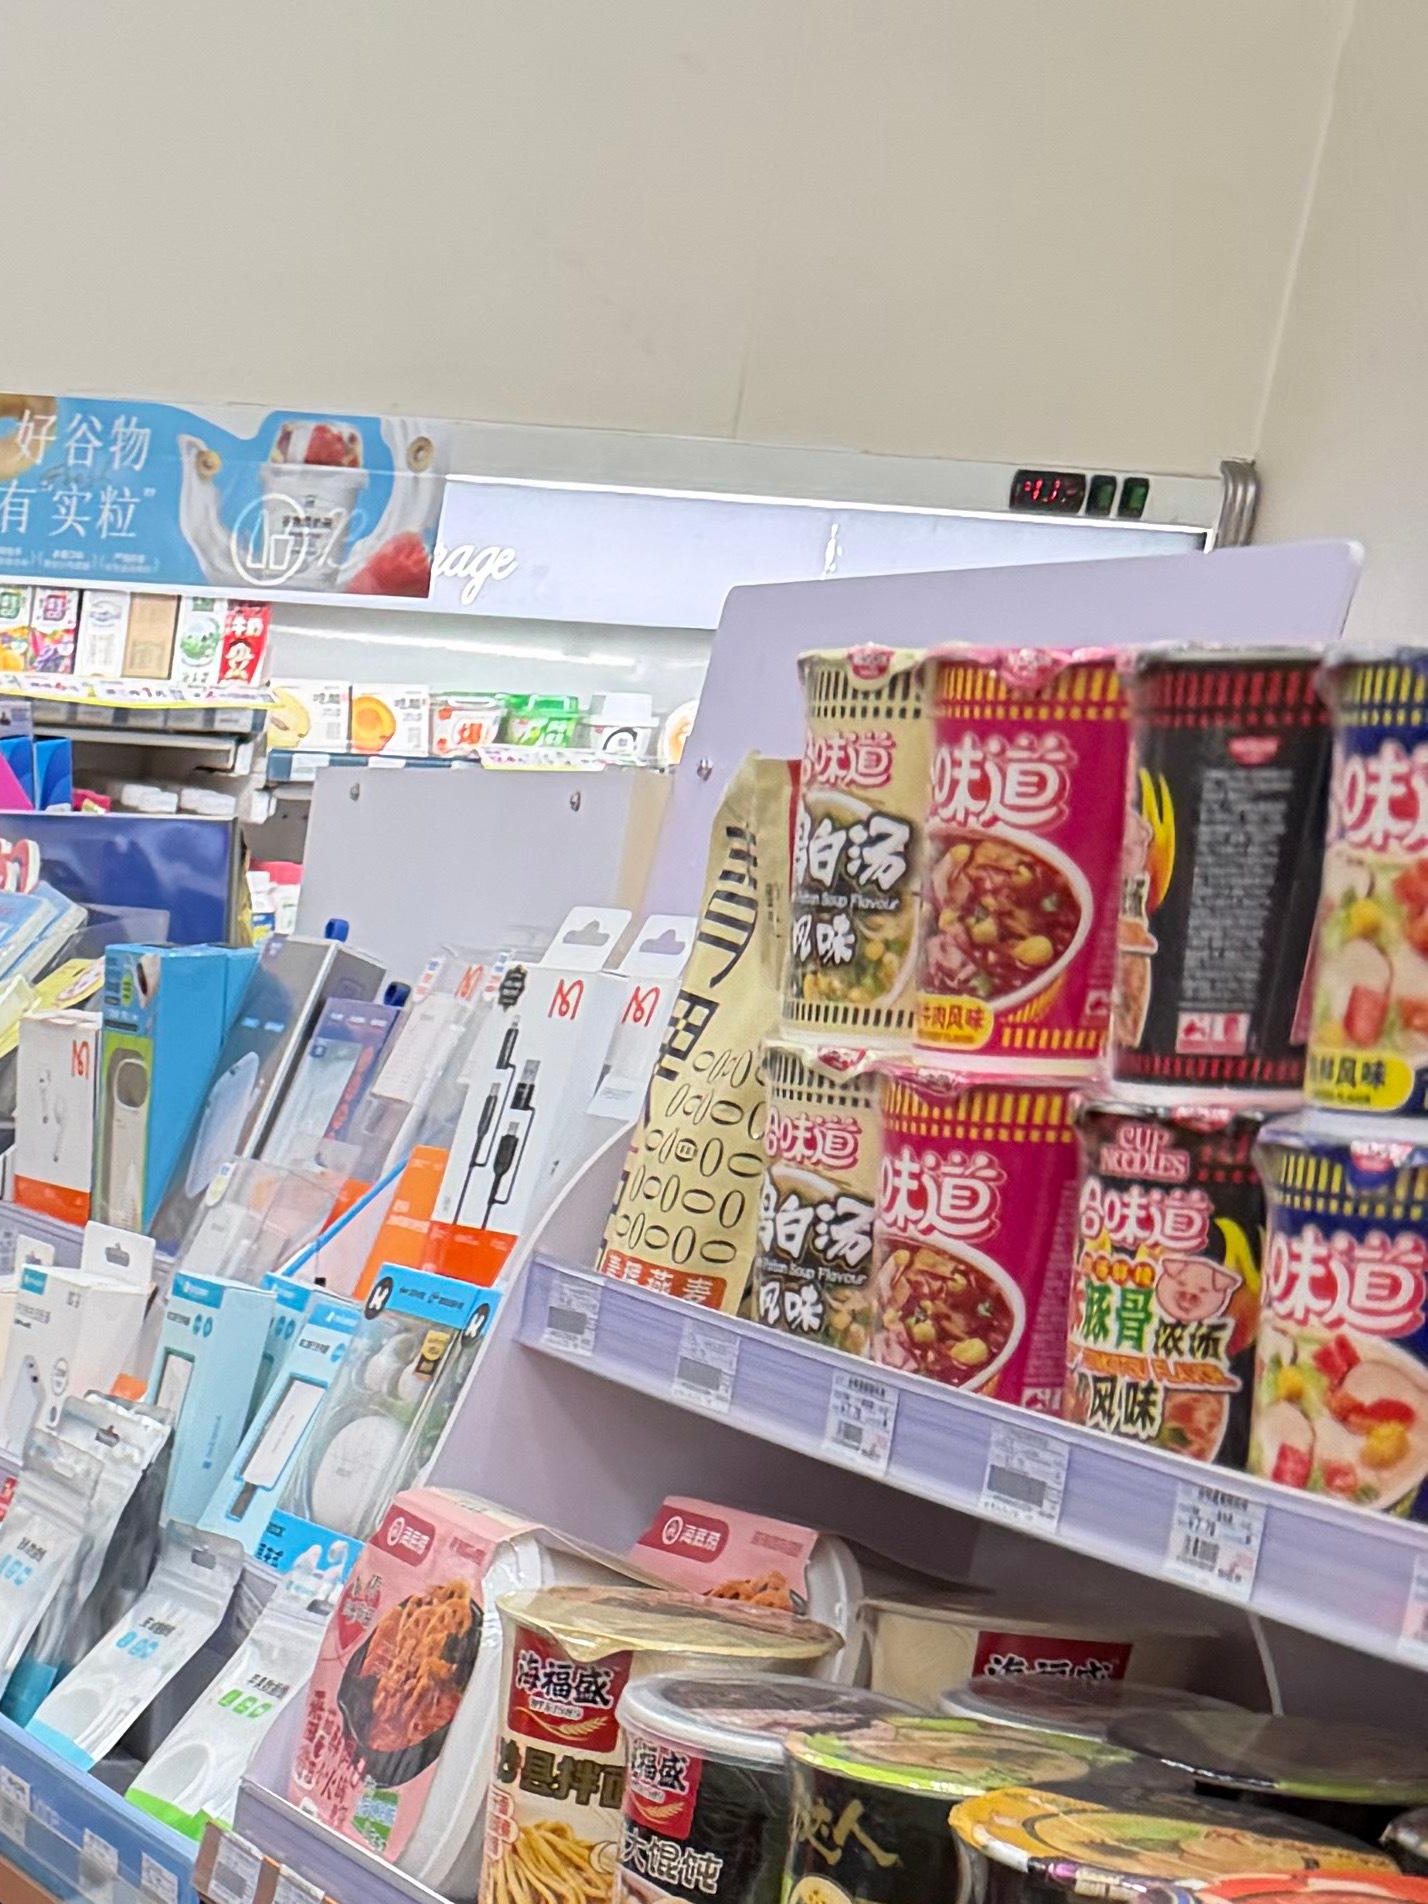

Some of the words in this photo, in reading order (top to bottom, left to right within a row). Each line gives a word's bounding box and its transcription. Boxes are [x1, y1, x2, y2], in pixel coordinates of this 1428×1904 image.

[15, 409, 151, 471] 好谷物
[1099, 1148, 1190, 1181] NOODLES
[1114, 1126, 1164, 1153] CUP
[1079, 1175, 1211, 1252] 合味道
[1085, 1375, 1162, 1441] 风味
[517, 1651, 613, 1707] 海福盛
[622, 1829, 724, 1895] 大馄饨
